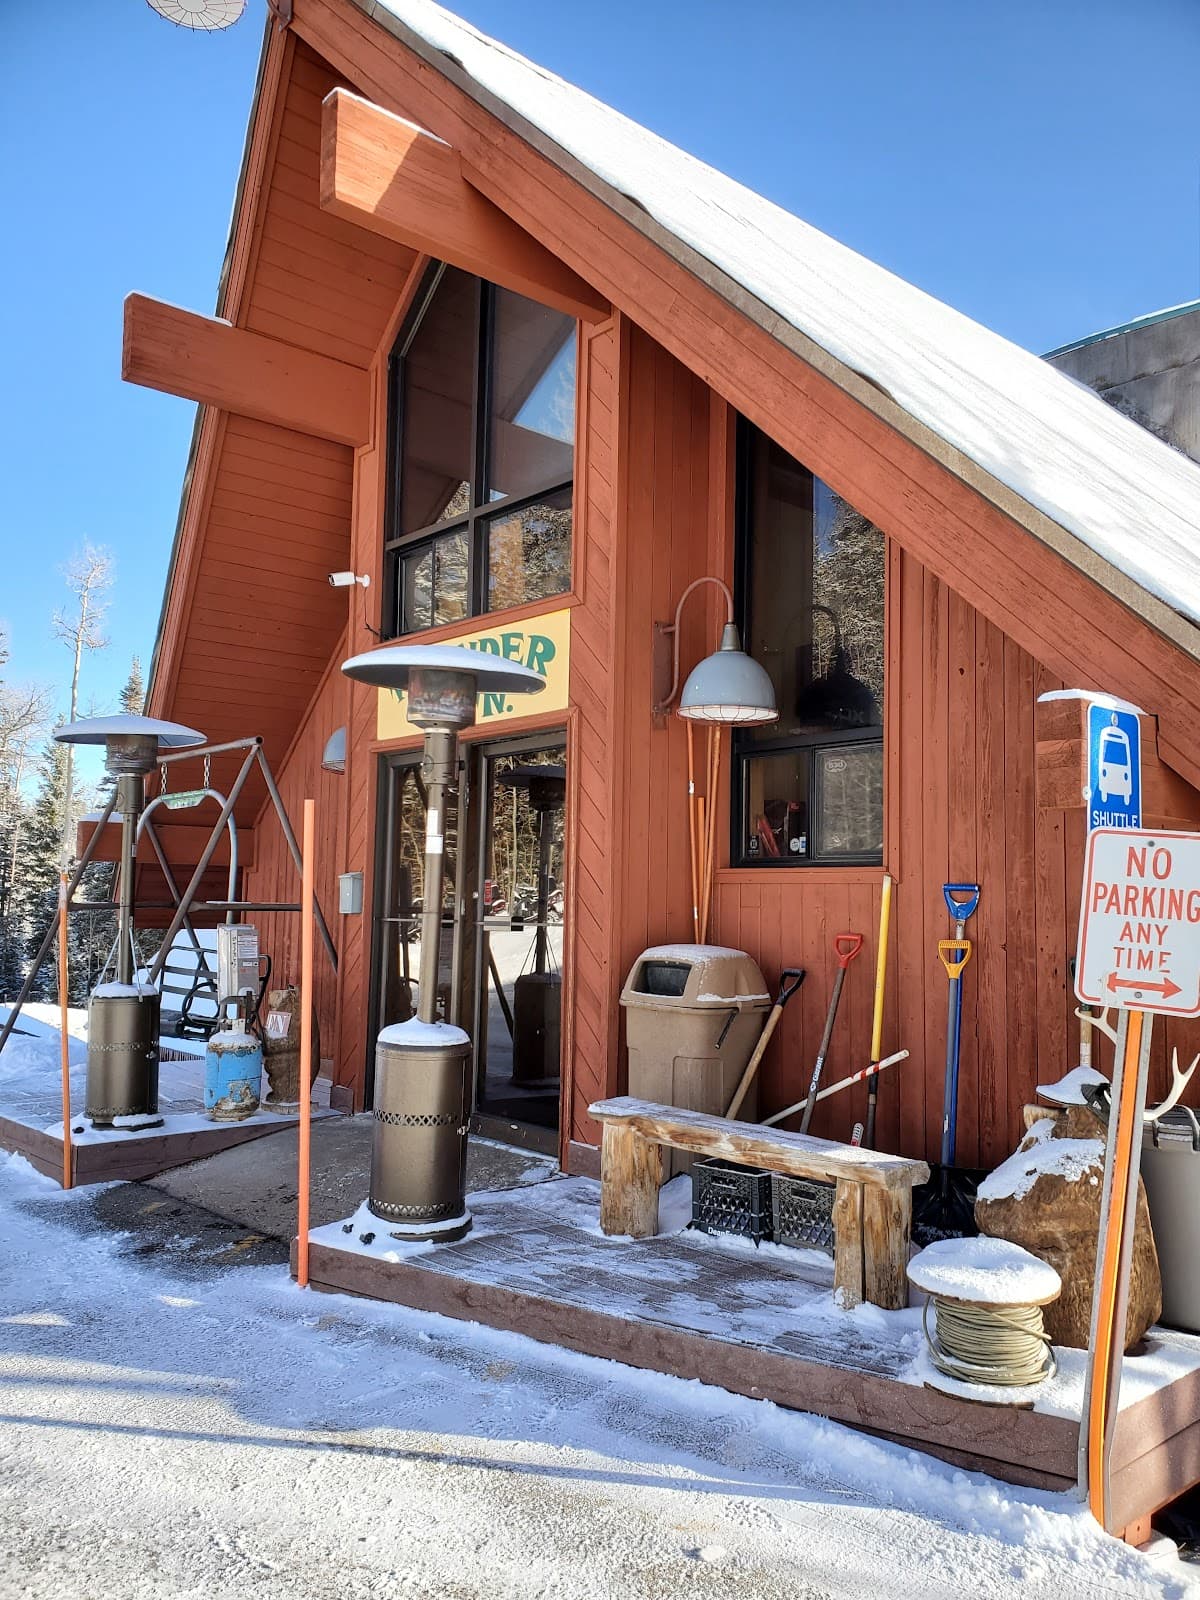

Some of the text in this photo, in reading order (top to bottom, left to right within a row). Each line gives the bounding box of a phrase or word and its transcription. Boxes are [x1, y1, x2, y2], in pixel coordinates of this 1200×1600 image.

[1093, 811, 1138, 828] SHUTTLE
[1126, 847, 1172, 880] NO
[1093, 882, 1200, 923] PARKING
[1120, 921, 1168, 945] ANY
[1113, 947, 1172, 973] TIME
